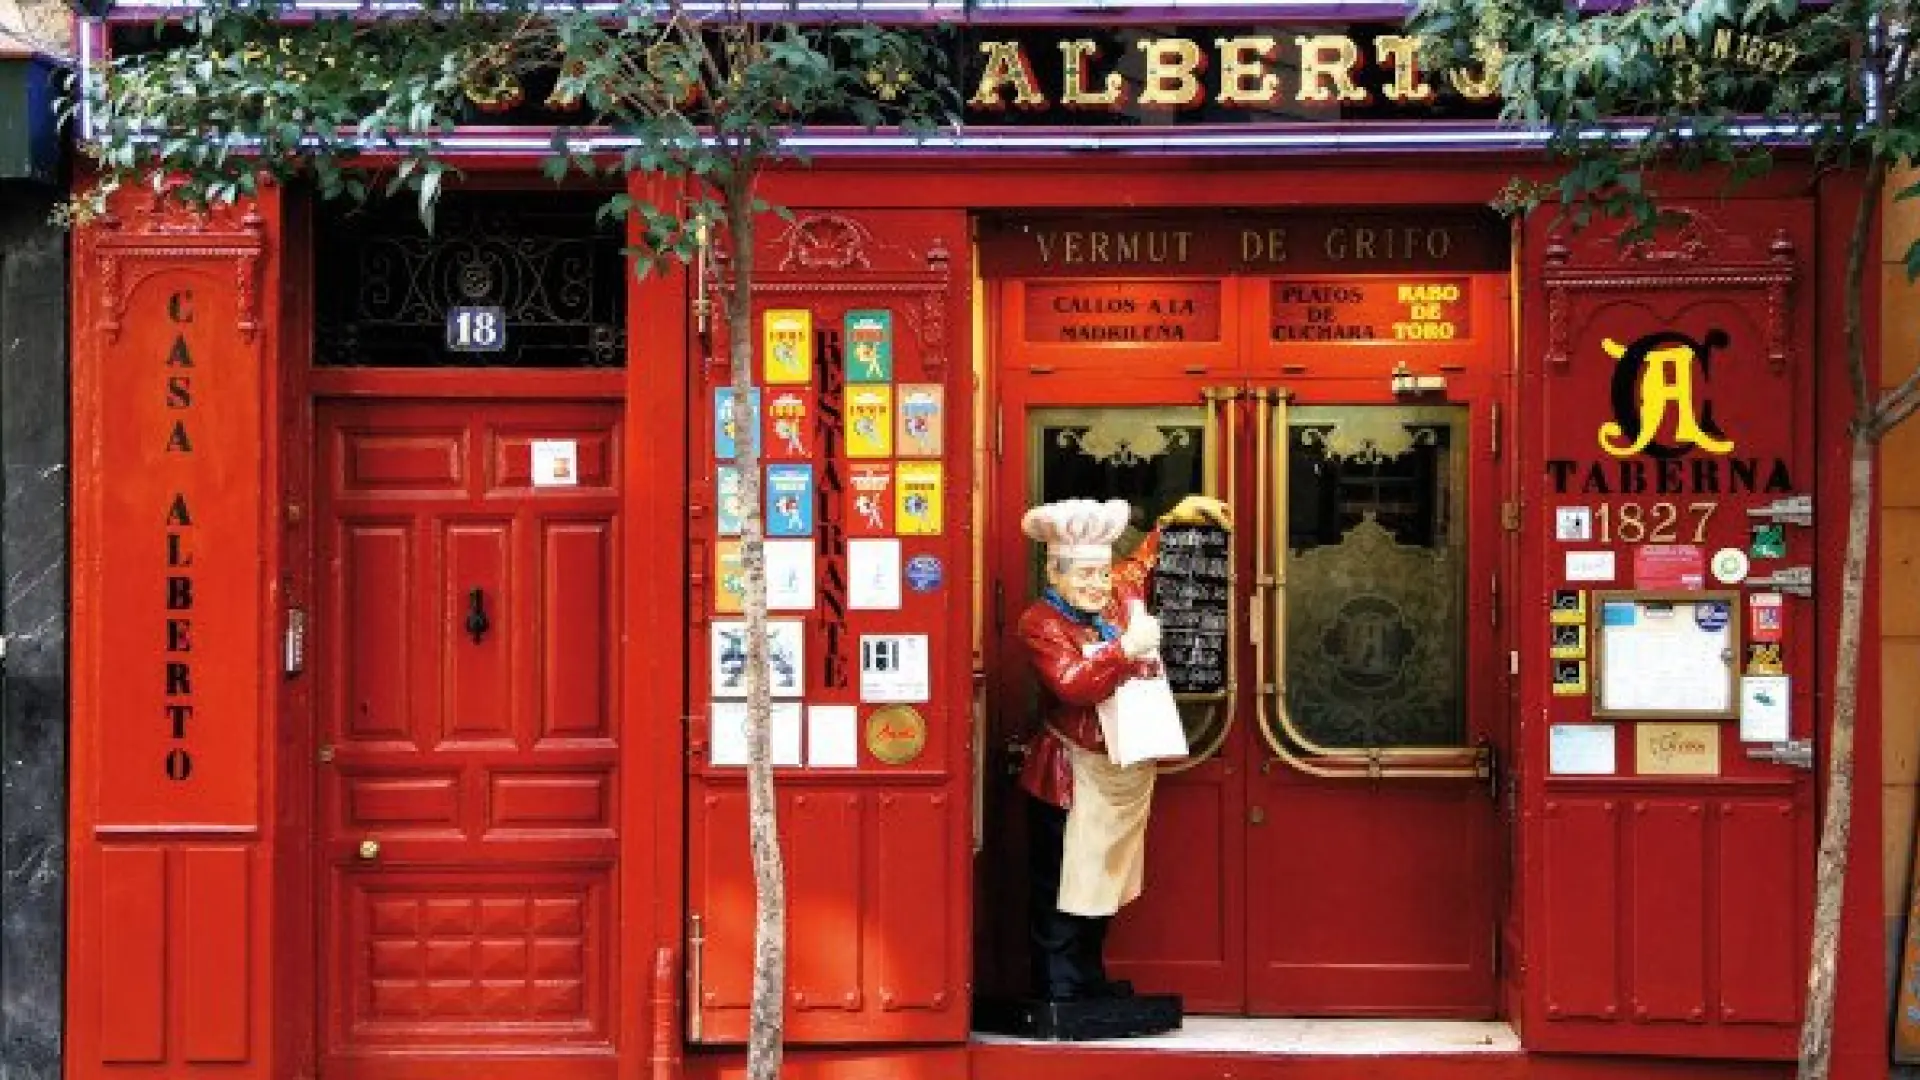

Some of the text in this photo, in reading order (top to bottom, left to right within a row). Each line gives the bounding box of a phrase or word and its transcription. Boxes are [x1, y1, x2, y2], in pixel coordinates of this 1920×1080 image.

[1036, 227, 1451, 263] VERMUT DE GRIFO
[1053, 297, 1195, 317] CALLOS A LA
[1281, 286, 1363, 304] PLATOS
[1411, 303, 1441, 320] DE
[456, 312, 497, 346] 18
[1307, 306, 1337, 323] DE
[1391, 321, 1455, 340] TORO
[1272, 325, 1376, 341] CUCHARA
[166, 289, 195, 452] CASA
[1547, 458, 1792, 494] TABERNA
[814, 328, 848, 690] RESTAURANTE
[1595, 502, 1718, 543] 1827
[165, 492, 193, 781] ALBERTO
